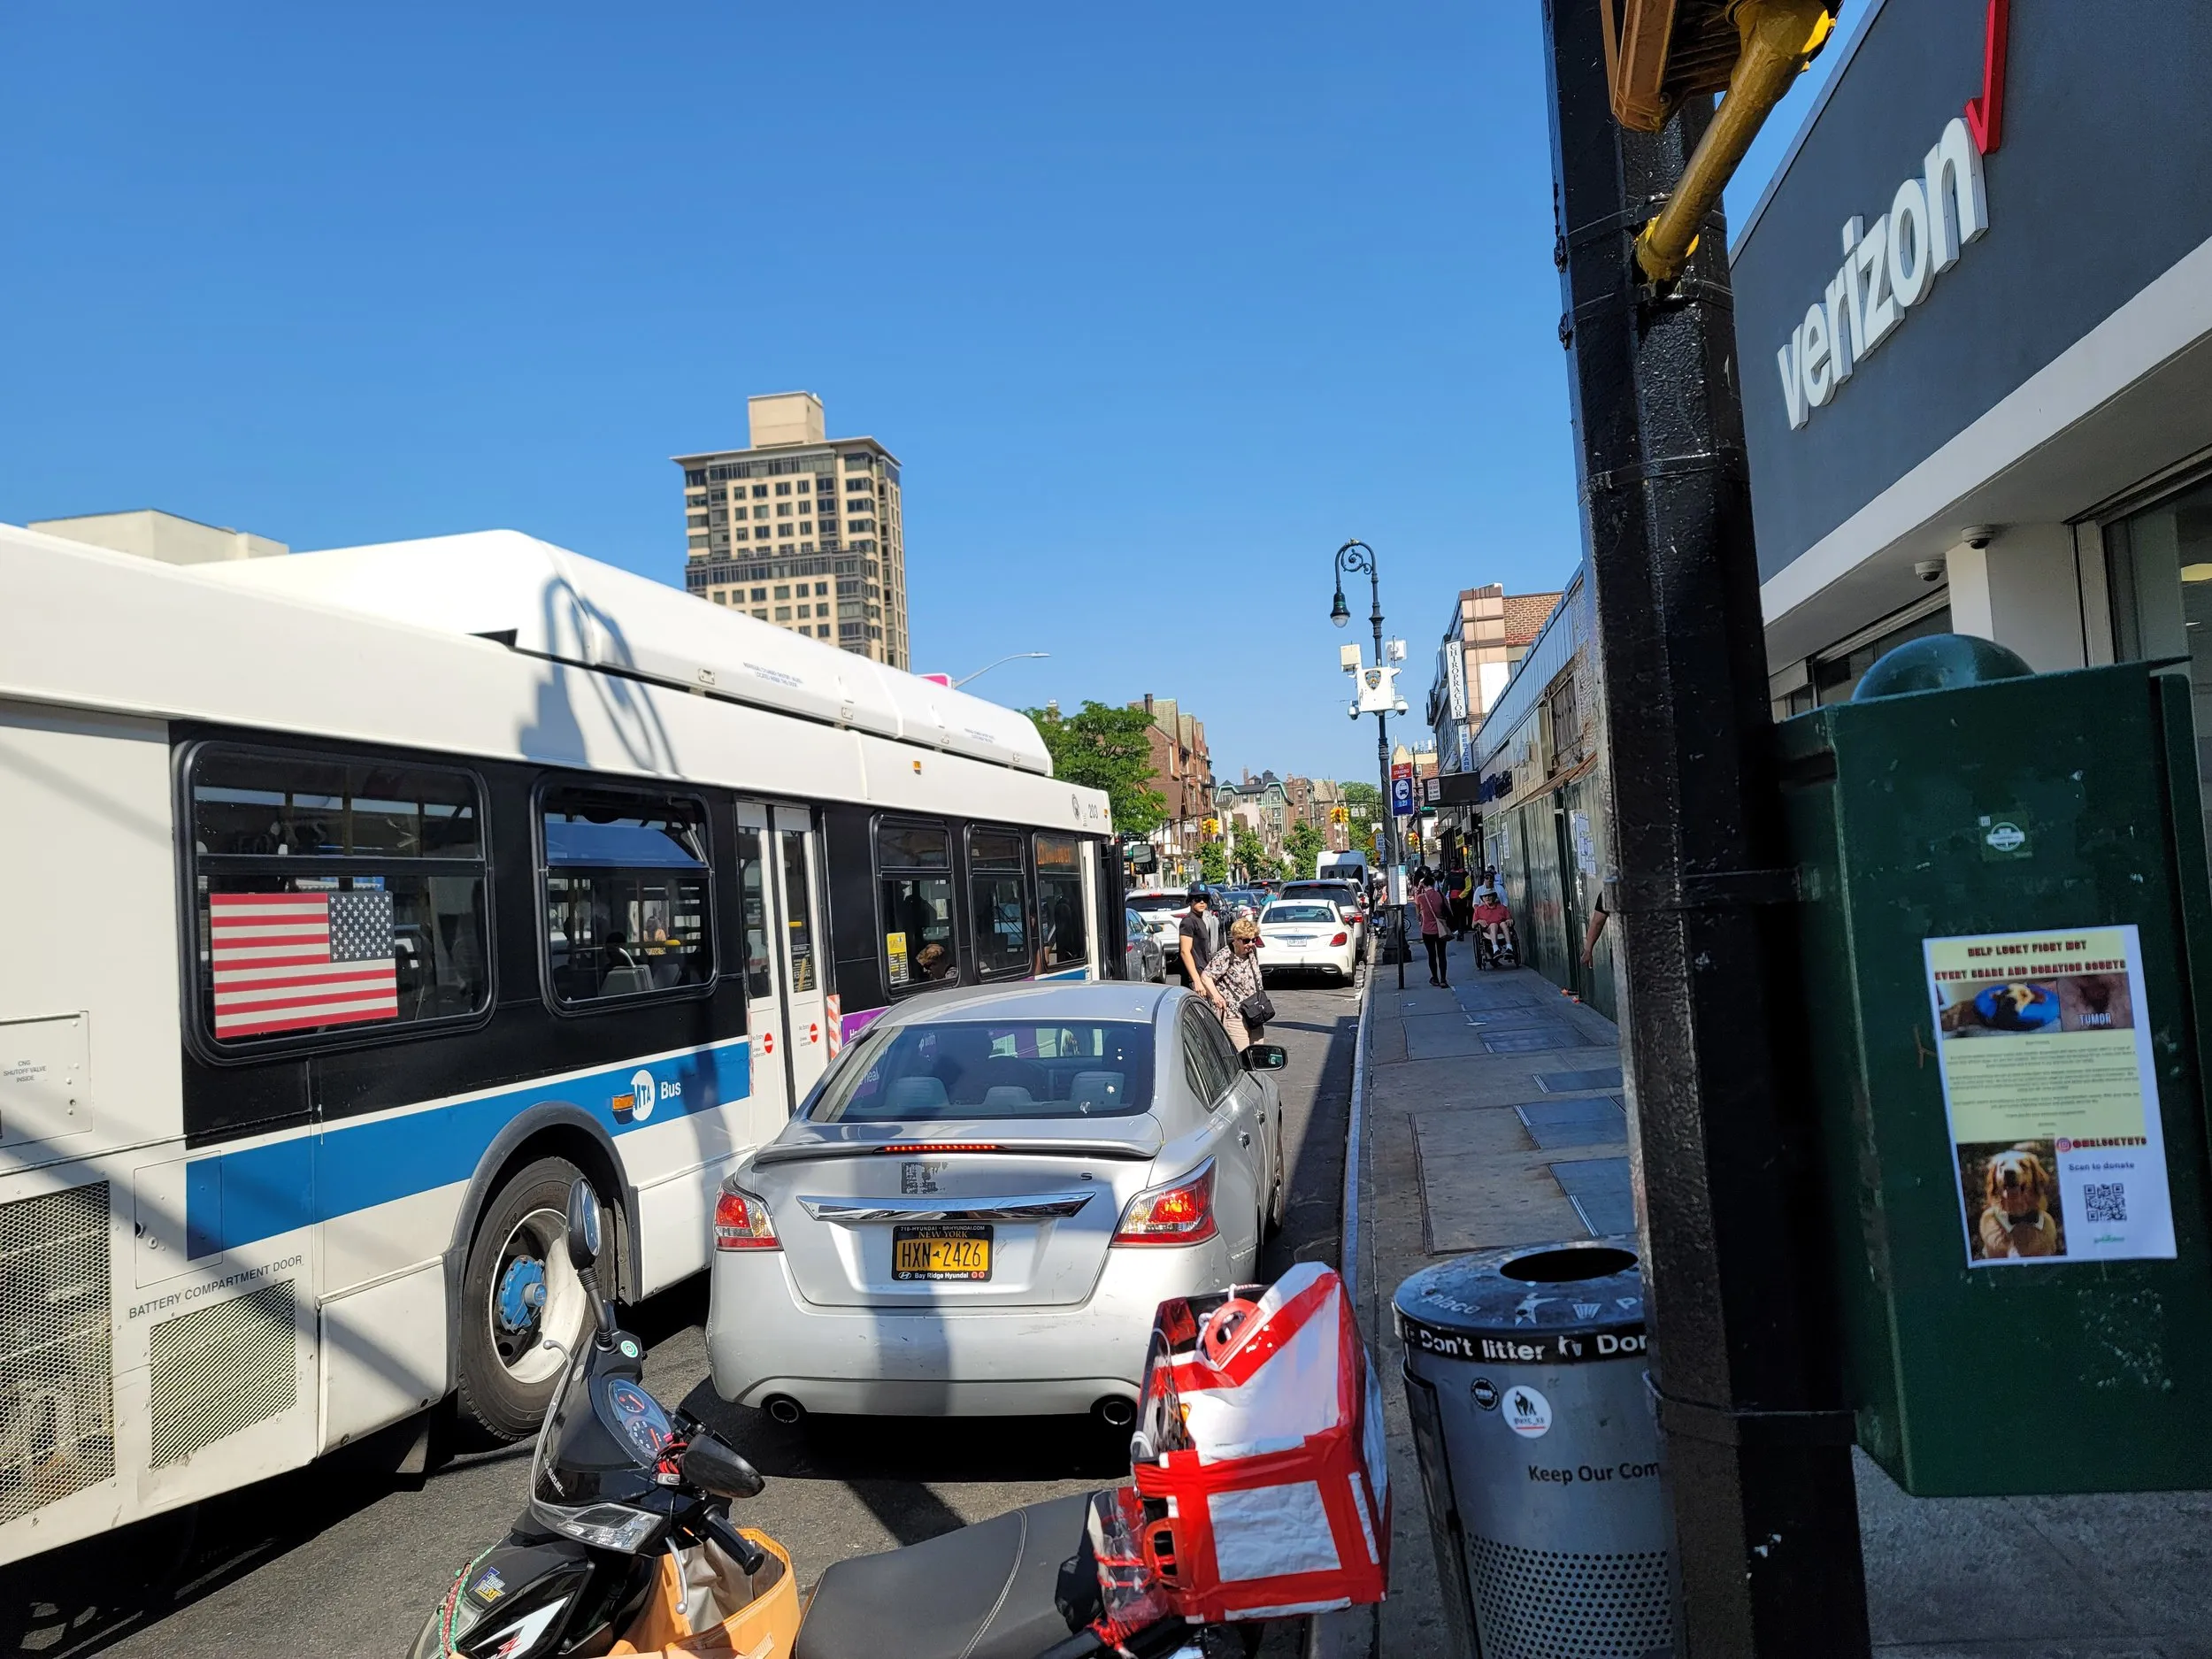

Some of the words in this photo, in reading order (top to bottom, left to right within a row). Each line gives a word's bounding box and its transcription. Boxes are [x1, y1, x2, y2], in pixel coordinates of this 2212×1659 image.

[1777, 117, 1989, 431] verizon
[1449, 643, 1463, 718] CHIROPRACTOR
[1968, 946, 1993, 956] HELP
[1935, 970, 1968, 980] EVERY
[1971, 967, 2004, 978] SHARE
[2008, 965, 2029, 976] AND
[2031, 962, 2082, 974] DONATION
[2085, 959, 2126, 971] COUNTS
[2079, 1012, 2113, 1025] TUMOR
[3, 1067, 30, 1077] SHUTOFF
[661, 1081, 681, 1100] Bus
[2069, 1163, 2090, 1171] Scan
[2103, 1160, 2135, 1169] donate
[1080, 1172, 1093, 1181] S
[902, 1242, 932, 1267] HXN
[943, 1242, 980, 1267] 2426
[914, 1271, 926, 1280] Bay
[926, 1271, 944, 1280] Ridge
[129, 1292, 181, 1319] BATTERY
[185, 1264, 271, 1301] COMPARTMENT
[273, 1255, 303, 1272] DOOR
[1425, 1293, 1481, 1314] place
[1419, 1329, 1473, 1356] Don't
[1481, 1339, 1546, 1360] litter
[547, 1467, 565, 1494] SUZUKI
[1528, 1464, 1572, 1486] Keep
[1578, 1465, 1614, 1482] Our
